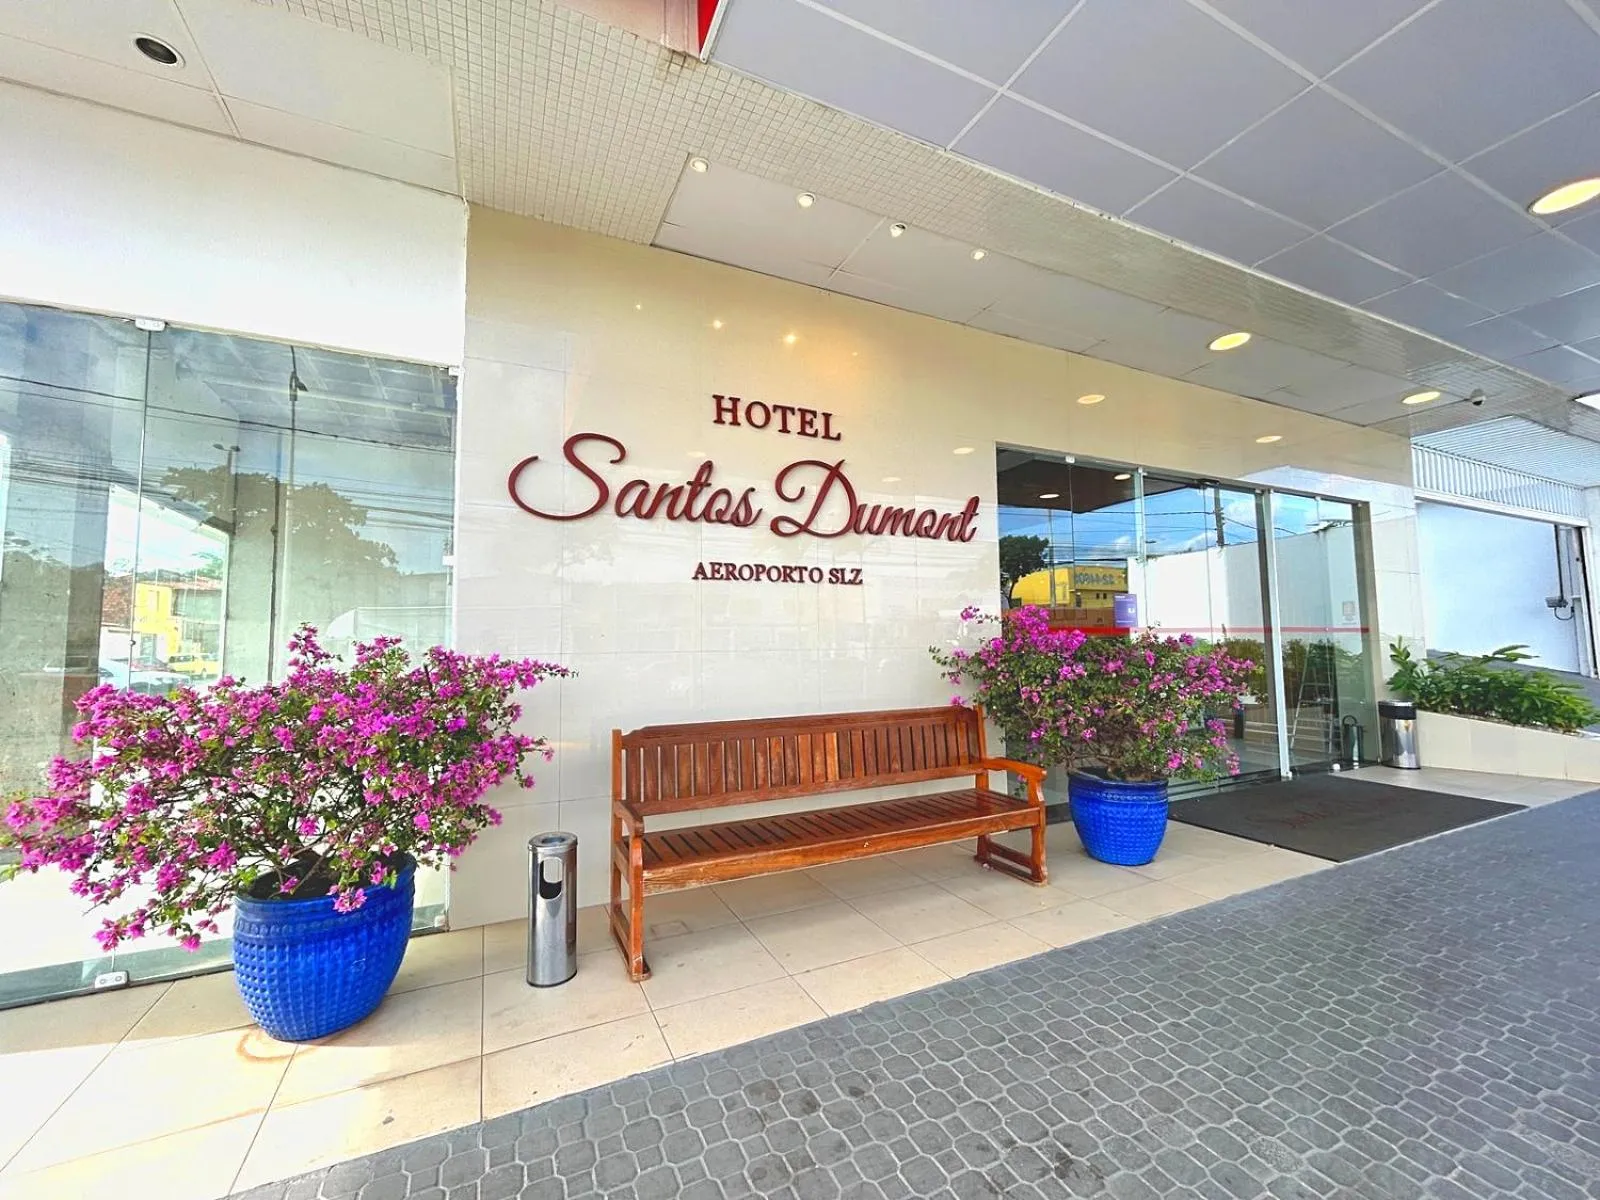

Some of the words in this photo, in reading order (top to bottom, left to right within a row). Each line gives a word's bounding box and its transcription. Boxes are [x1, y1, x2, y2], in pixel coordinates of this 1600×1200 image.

[712, 394, 842, 442] HOTEL
[508, 432, 763, 527] Santos
[770, 459, 979, 543] Dumont
[693, 561, 824, 586] AEROPORTO
[828, 567, 863, 586] SLZ
